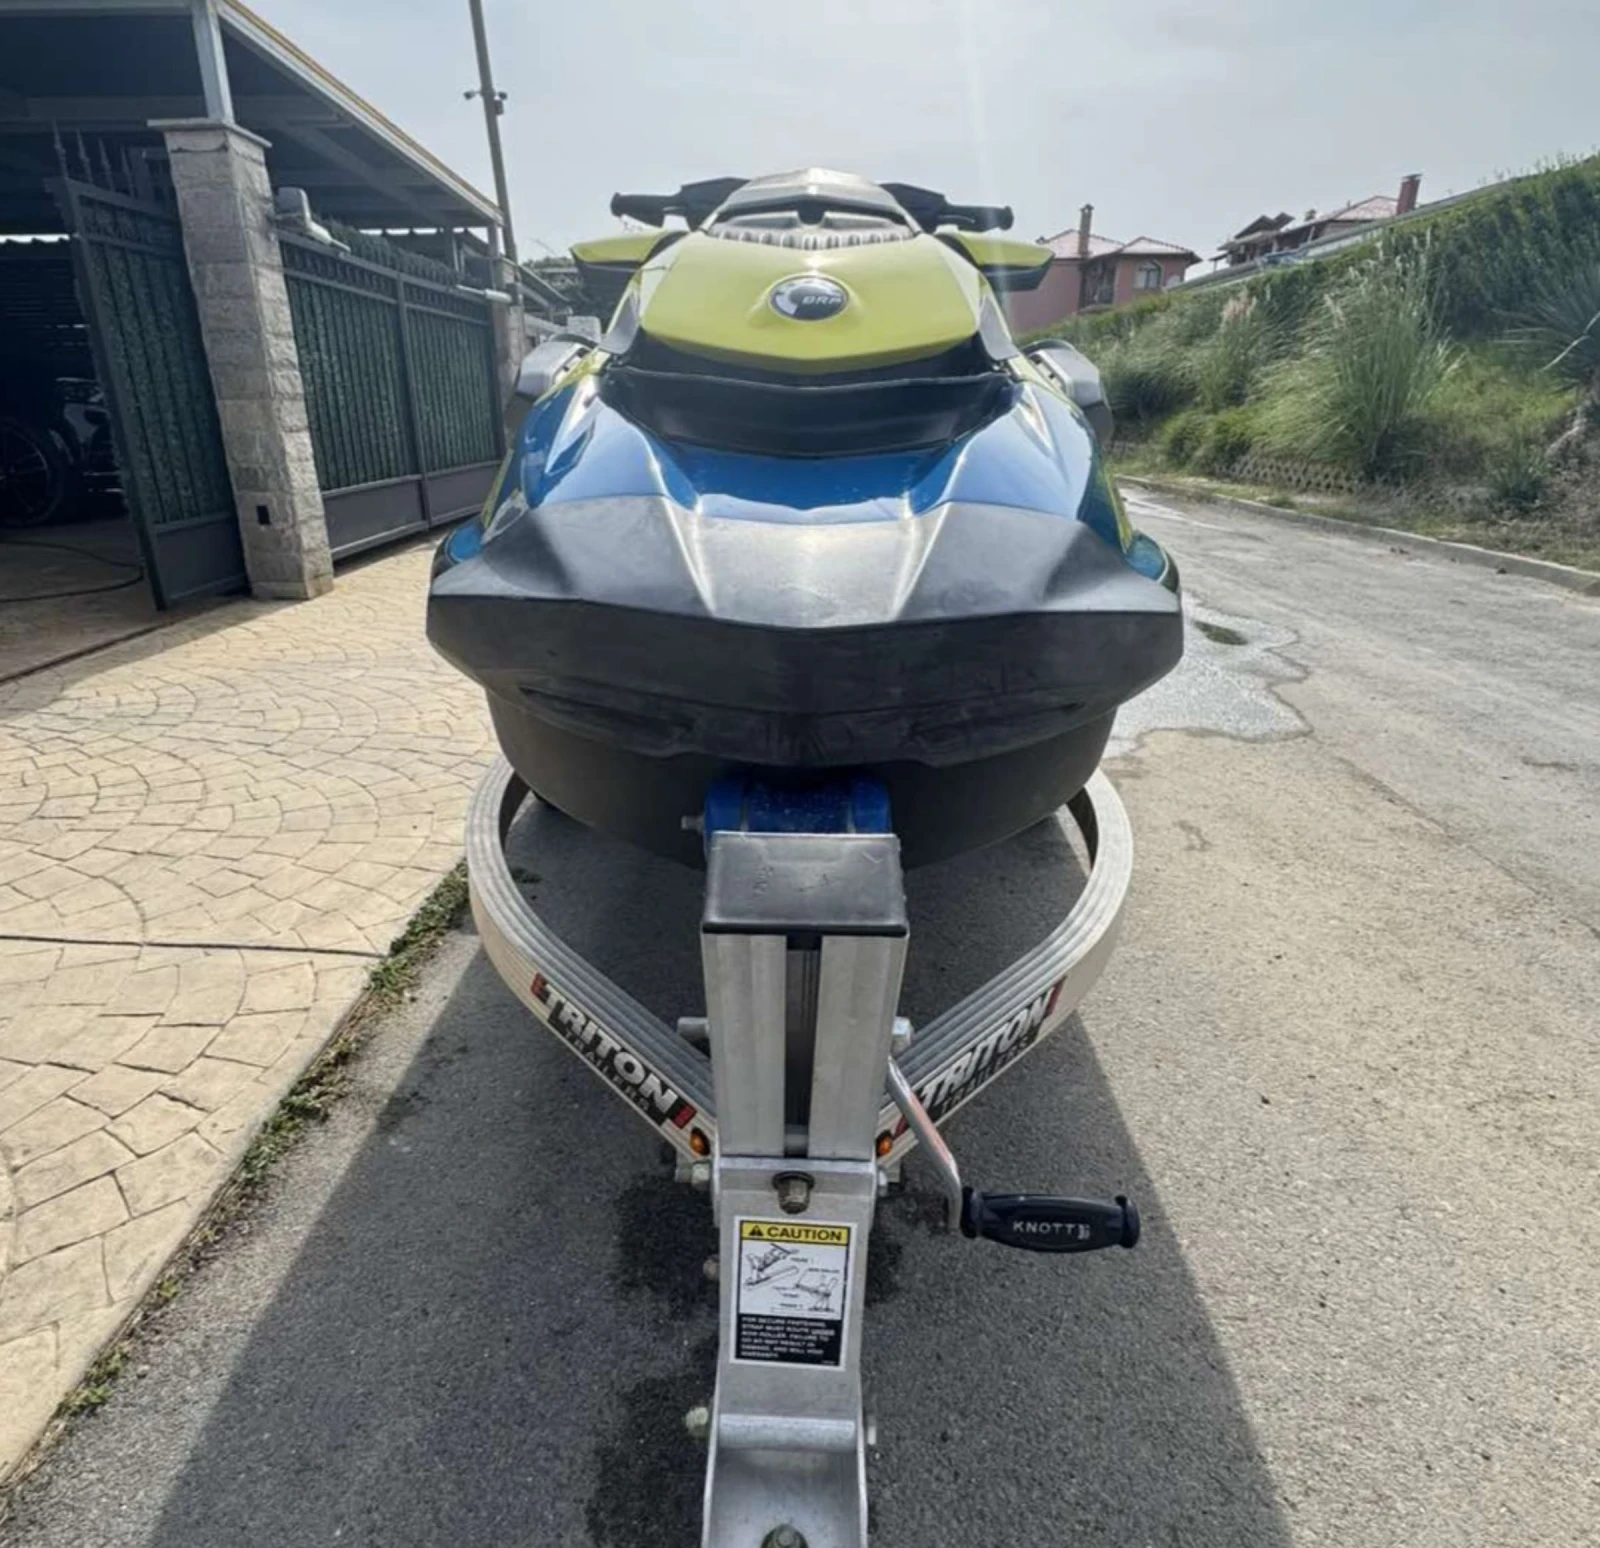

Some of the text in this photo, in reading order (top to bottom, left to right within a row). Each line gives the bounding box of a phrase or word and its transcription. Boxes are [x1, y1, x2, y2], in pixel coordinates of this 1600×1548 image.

[801, 295, 842, 305] BRP
[545, 983, 679, 1113] TRITON
[918, 986, 1056, 1109] TRITON
[767, 1226, 842, 1241] CAUTION
[1012, 1220, 1075, 1235] KNOTT
